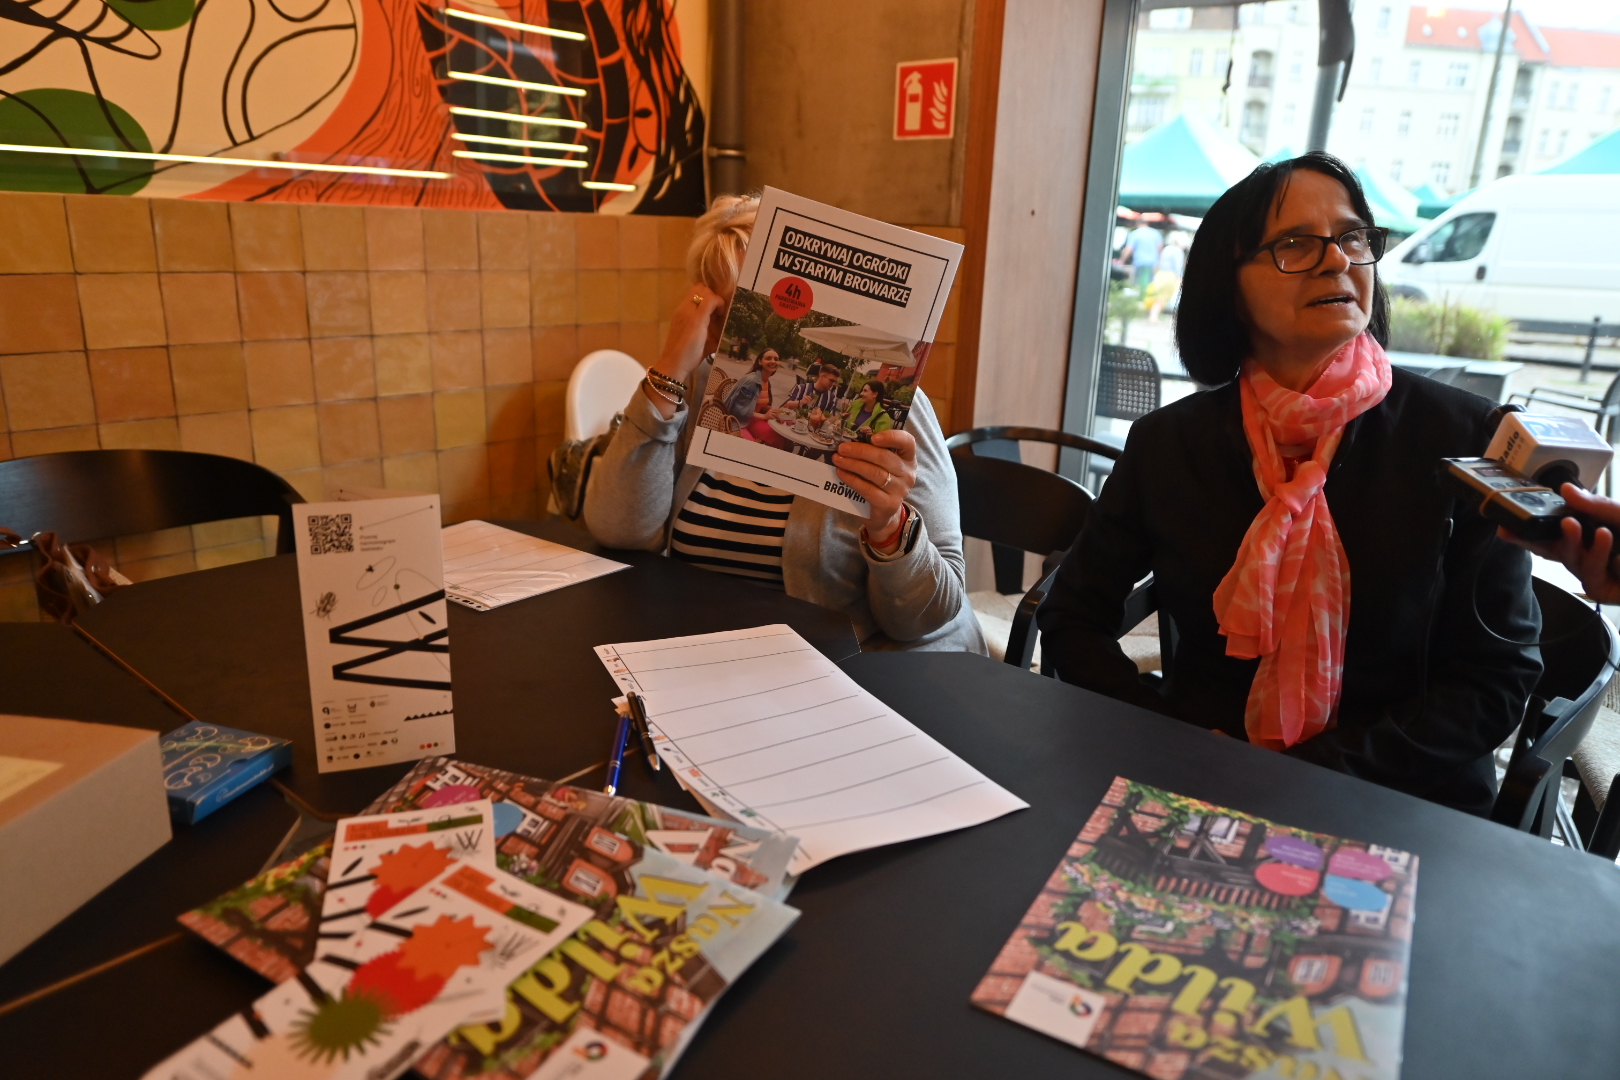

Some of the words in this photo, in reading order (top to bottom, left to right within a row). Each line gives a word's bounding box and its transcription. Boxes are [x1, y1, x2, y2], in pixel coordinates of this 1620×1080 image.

[779, 252, 793, 268] W
[792, 257, 843, 284] STARYM
[844, 273, 911, 304] BROWARZE
[785, 231, 852, 266] ODKRYWAJ
[853, 252, 909, 280] OGRÓDKI
[785, 283, 802, 300] 4h
[625, 890, 756, 995] Nasza
[1052, 921, 1369, 1062] Wilda
